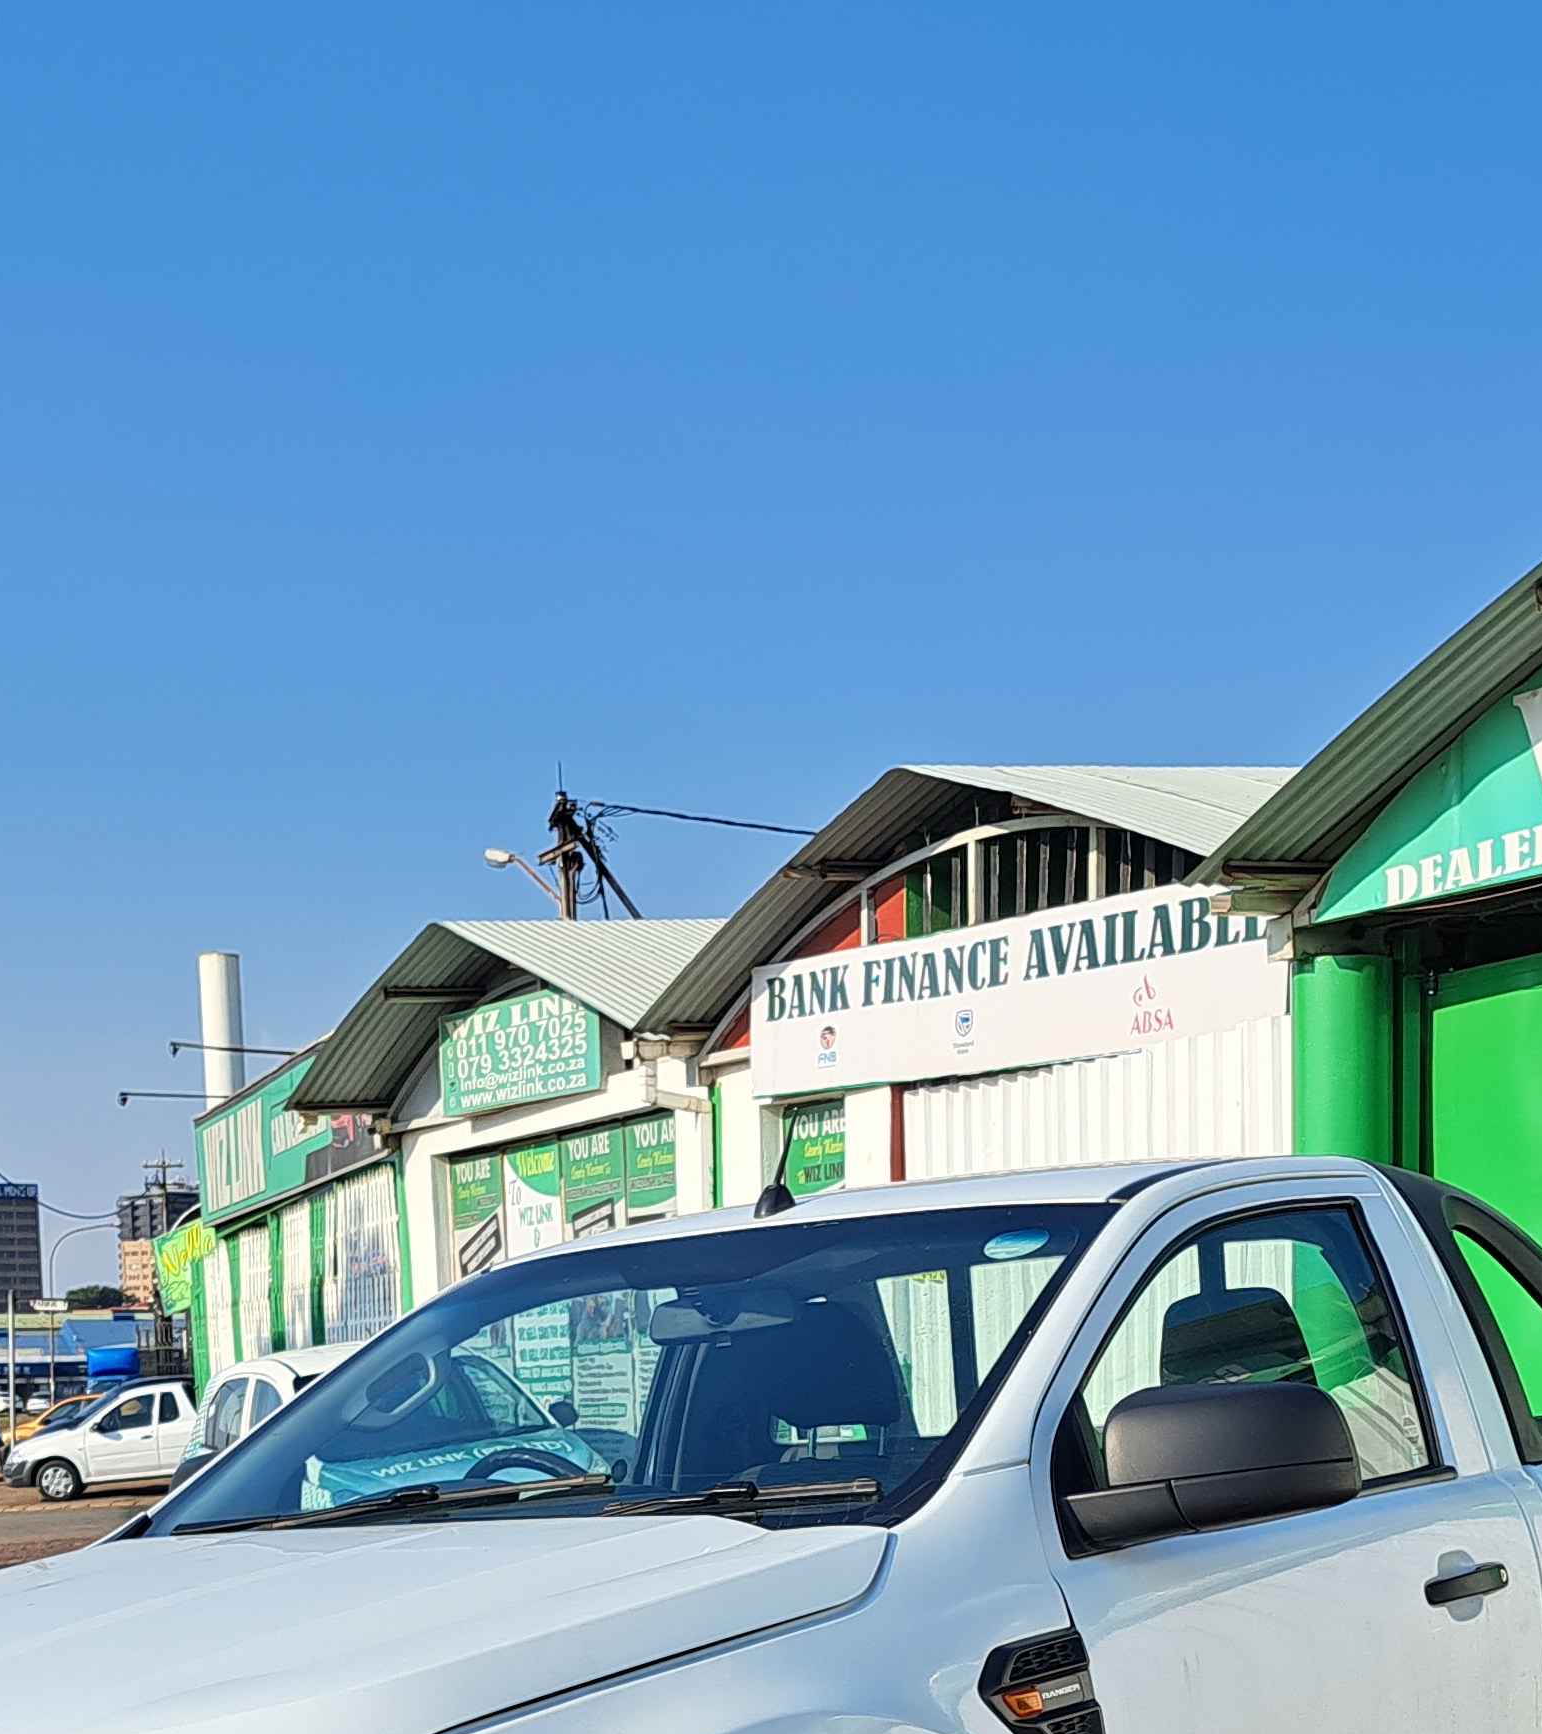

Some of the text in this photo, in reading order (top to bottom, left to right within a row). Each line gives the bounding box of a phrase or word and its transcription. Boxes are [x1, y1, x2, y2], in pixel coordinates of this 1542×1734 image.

[766, 964, 850, 1022] BANK
[862, 936, 1009, 1007] FINANCE
[445, 1010, 500, 1041] WIZ
[457, 1011, 587, 1058] 011 970 7025
[1131, 1008, 1174, 1035] ABSA
[458, 1033, 587, 1079] 079 3324325
[460, 1073, 587, 1108] www.wizlink.co.za
[568, 1133, 610, 1161] YOU ARE
[634, 1123, 658, 1148] YOU
[455, 1158, 491, 1184] YOU ARE
[371, 1461, 418, 1478] WIZ
[419, 1451, 472, 1469] LINK
